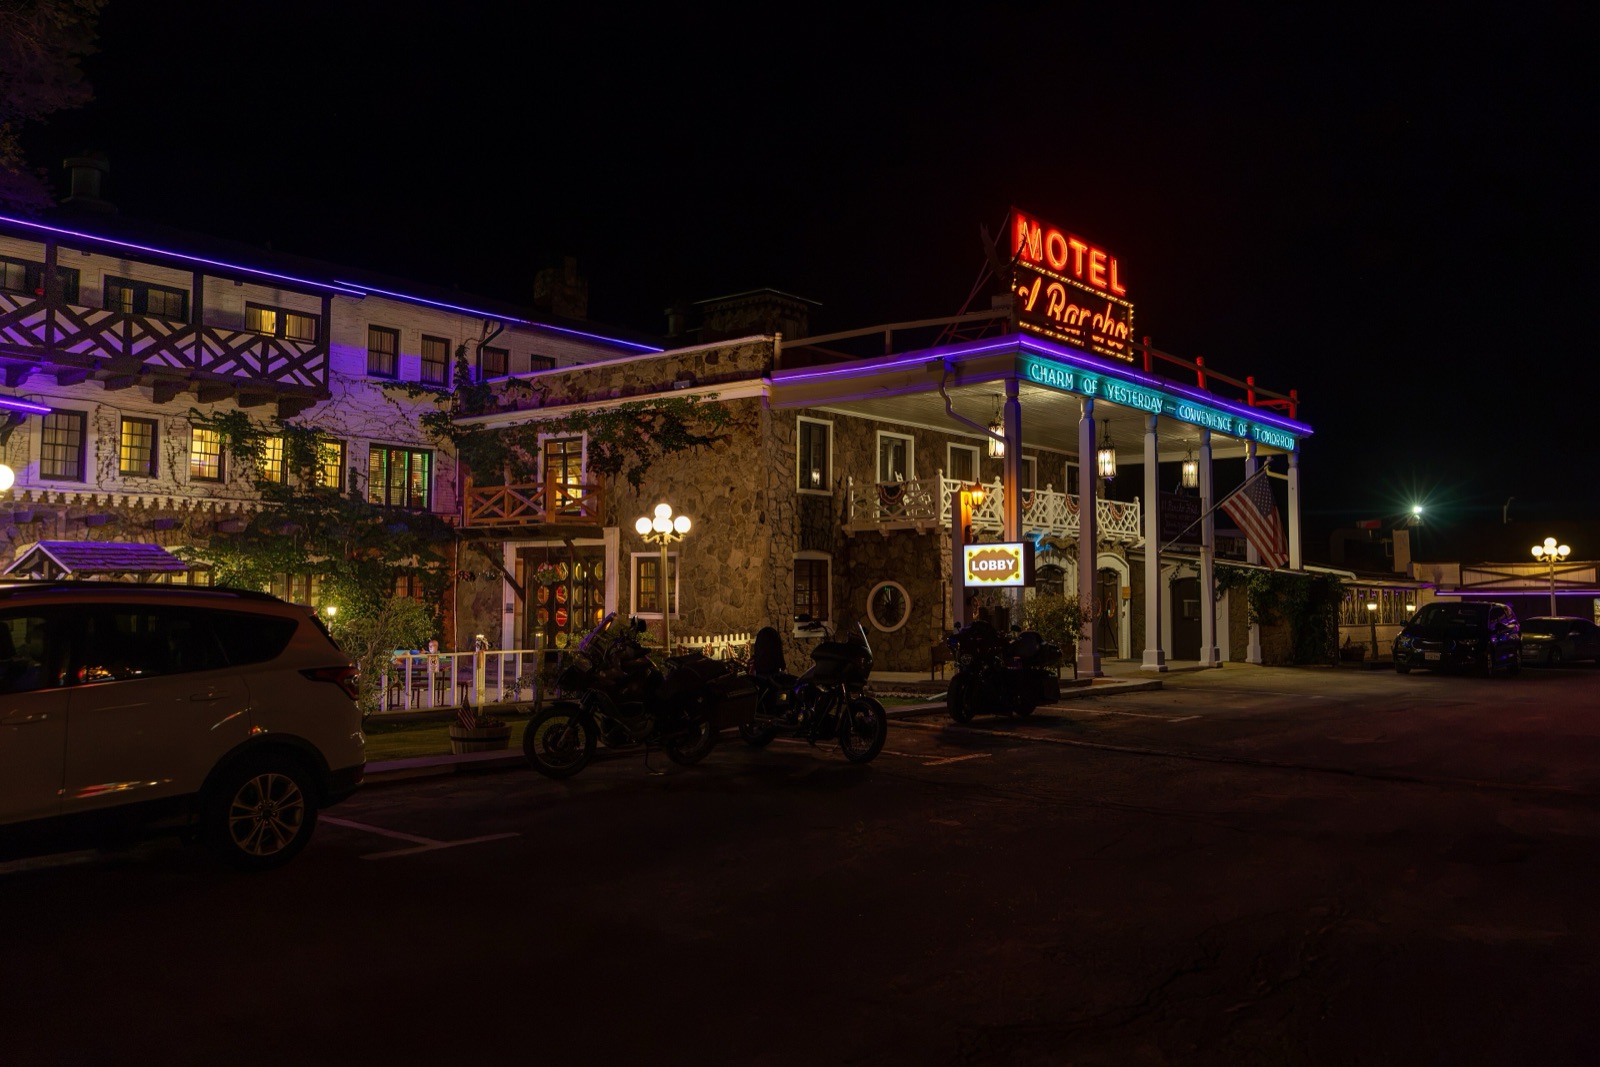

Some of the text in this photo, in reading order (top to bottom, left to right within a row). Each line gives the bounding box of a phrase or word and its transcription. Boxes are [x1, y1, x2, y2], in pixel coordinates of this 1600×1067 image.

[1016, 214, 1126, 296] MOTEL
[1031, 364, 1074, 390] CHARM
[1084, 378, 1098, 393] OF
[1106, 384, 1163, 413] YESTERDAY
[1179, 405, 1232, 431] CONVENIENCE
[1238, 423, 1248, 437] OF
[1254, 427, 1295, 451] TOMORROW
[971, 559, 1015, 571] LOBBY
